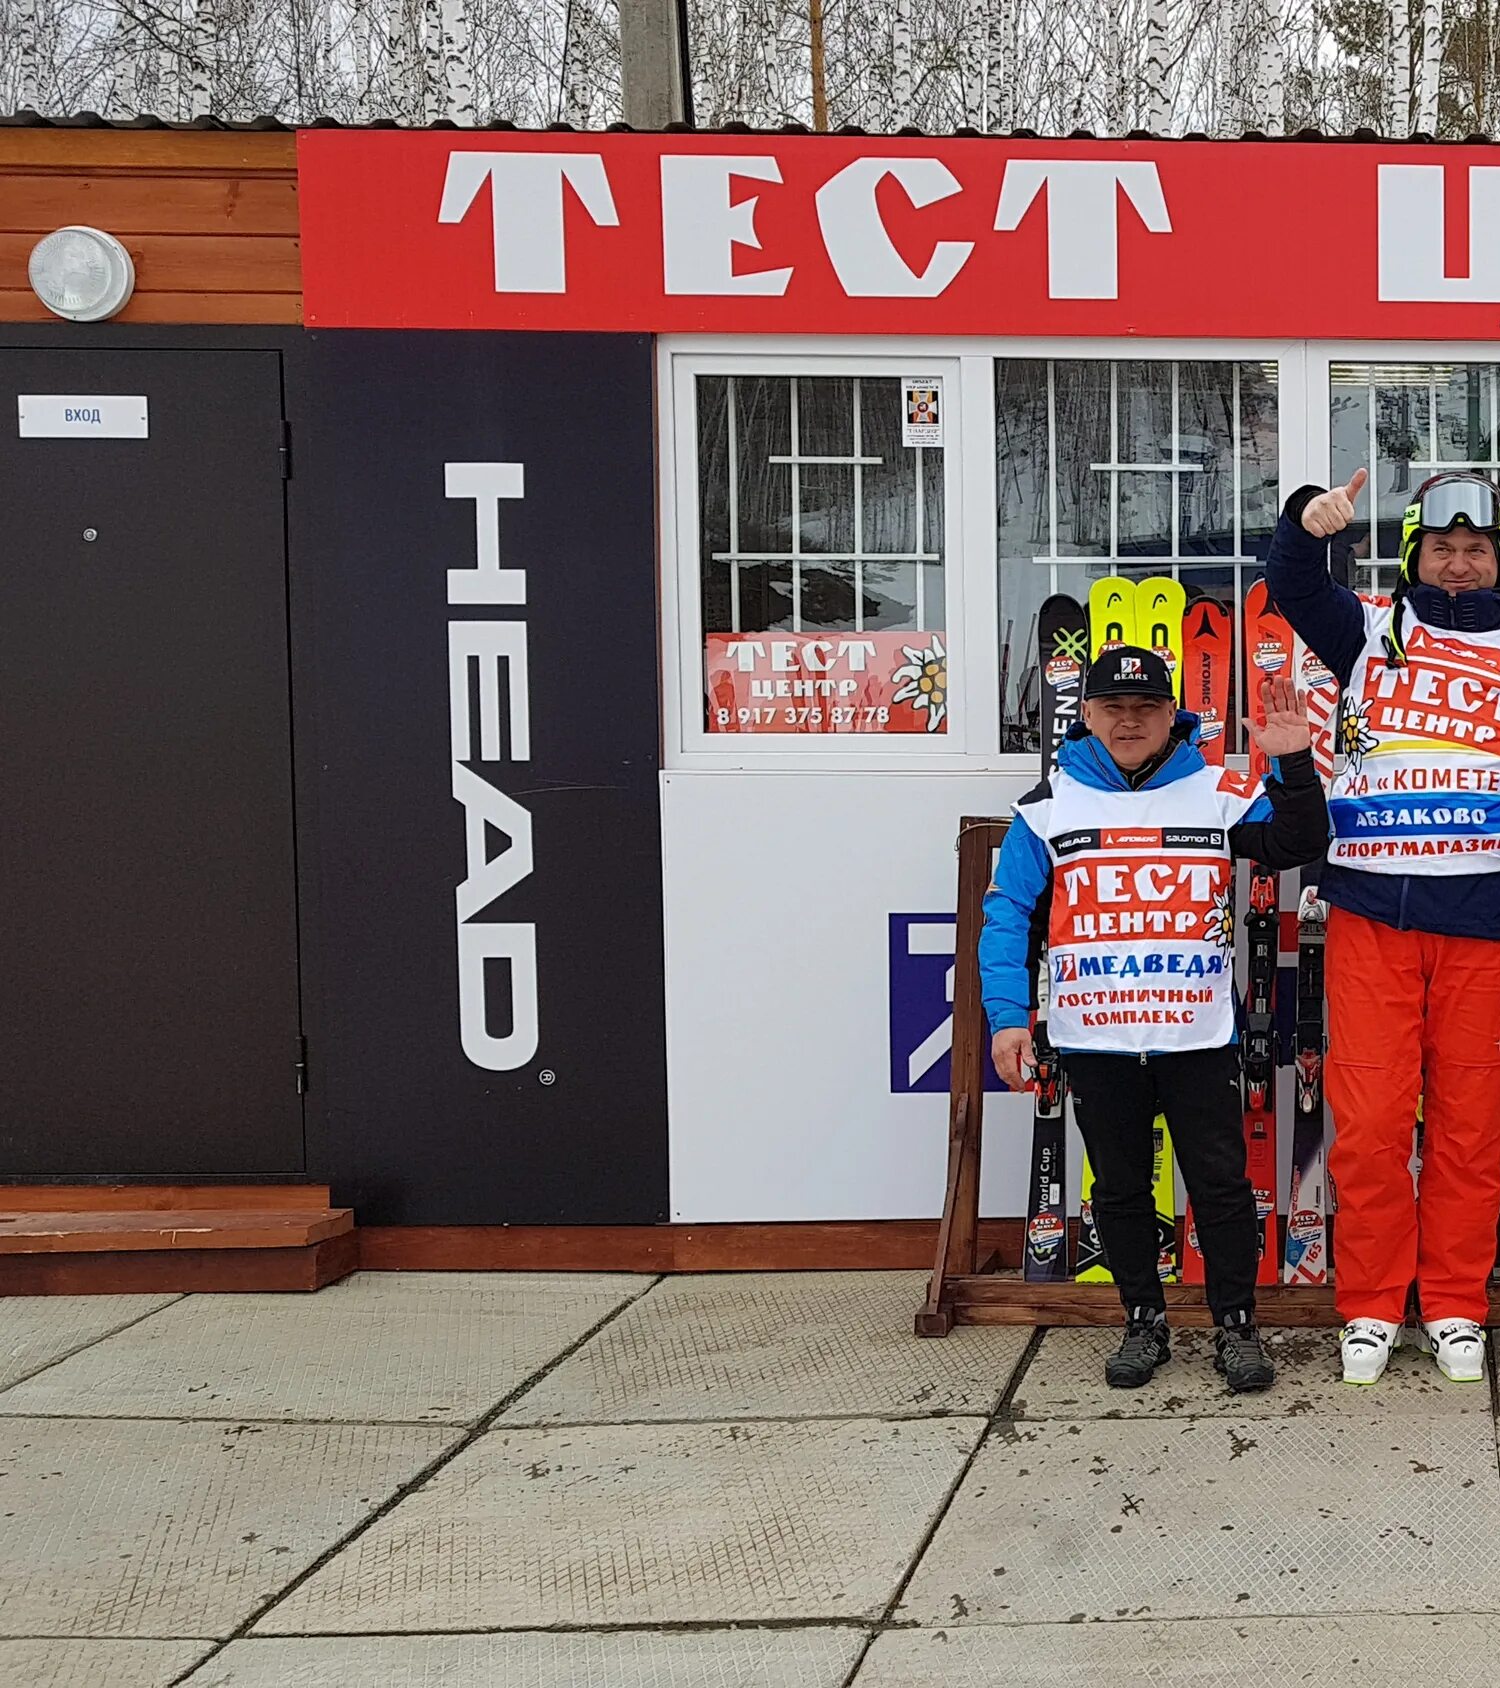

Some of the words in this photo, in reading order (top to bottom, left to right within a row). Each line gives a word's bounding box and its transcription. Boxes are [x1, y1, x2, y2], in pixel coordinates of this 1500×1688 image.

[438, 151, 1172, 299] ТЕСТ
[65, 408, 101, 424] ВХОД
[725, 640, 876, 672] ТЕСТ
[751, 679, 858, 700] ЦЕНТР
[1113, 672, 1149, 681] BEARS
[1202, 652, 1211, 705] ATOMIC
[717, 707, 730, 725] 8
[737, 707, 777, 724] 917
[784, 707, 823, 724] 375
[831, 707, 856, 724] 87
[864, 707, 890, 724] 78
[1380, 706, 1497, 744] ЦЕНТР
[444, 462, 540, 1071] HEAD
[1356, 807, 1488, 828] АБЗАКОВО
[1058, 836, 1092, 850] HEAD
[1063, 863, 1221, 907] ТЕСТ
[1073, 910, 1198, 939] ЦЕНТР
[1078, 953, 1223, 979] МЕДВЕДЯ
[1057, 986, 1214, 1008] ГОСТИНИЧНЫЙ
[1082, 1010, 1195, 1027] КОМПЛЕКС
[1040, 1147, 1052, 1173] Cup
[1039, 1176, 1050, 1214] World
[1306, 1242, 1323, 1264] 165
